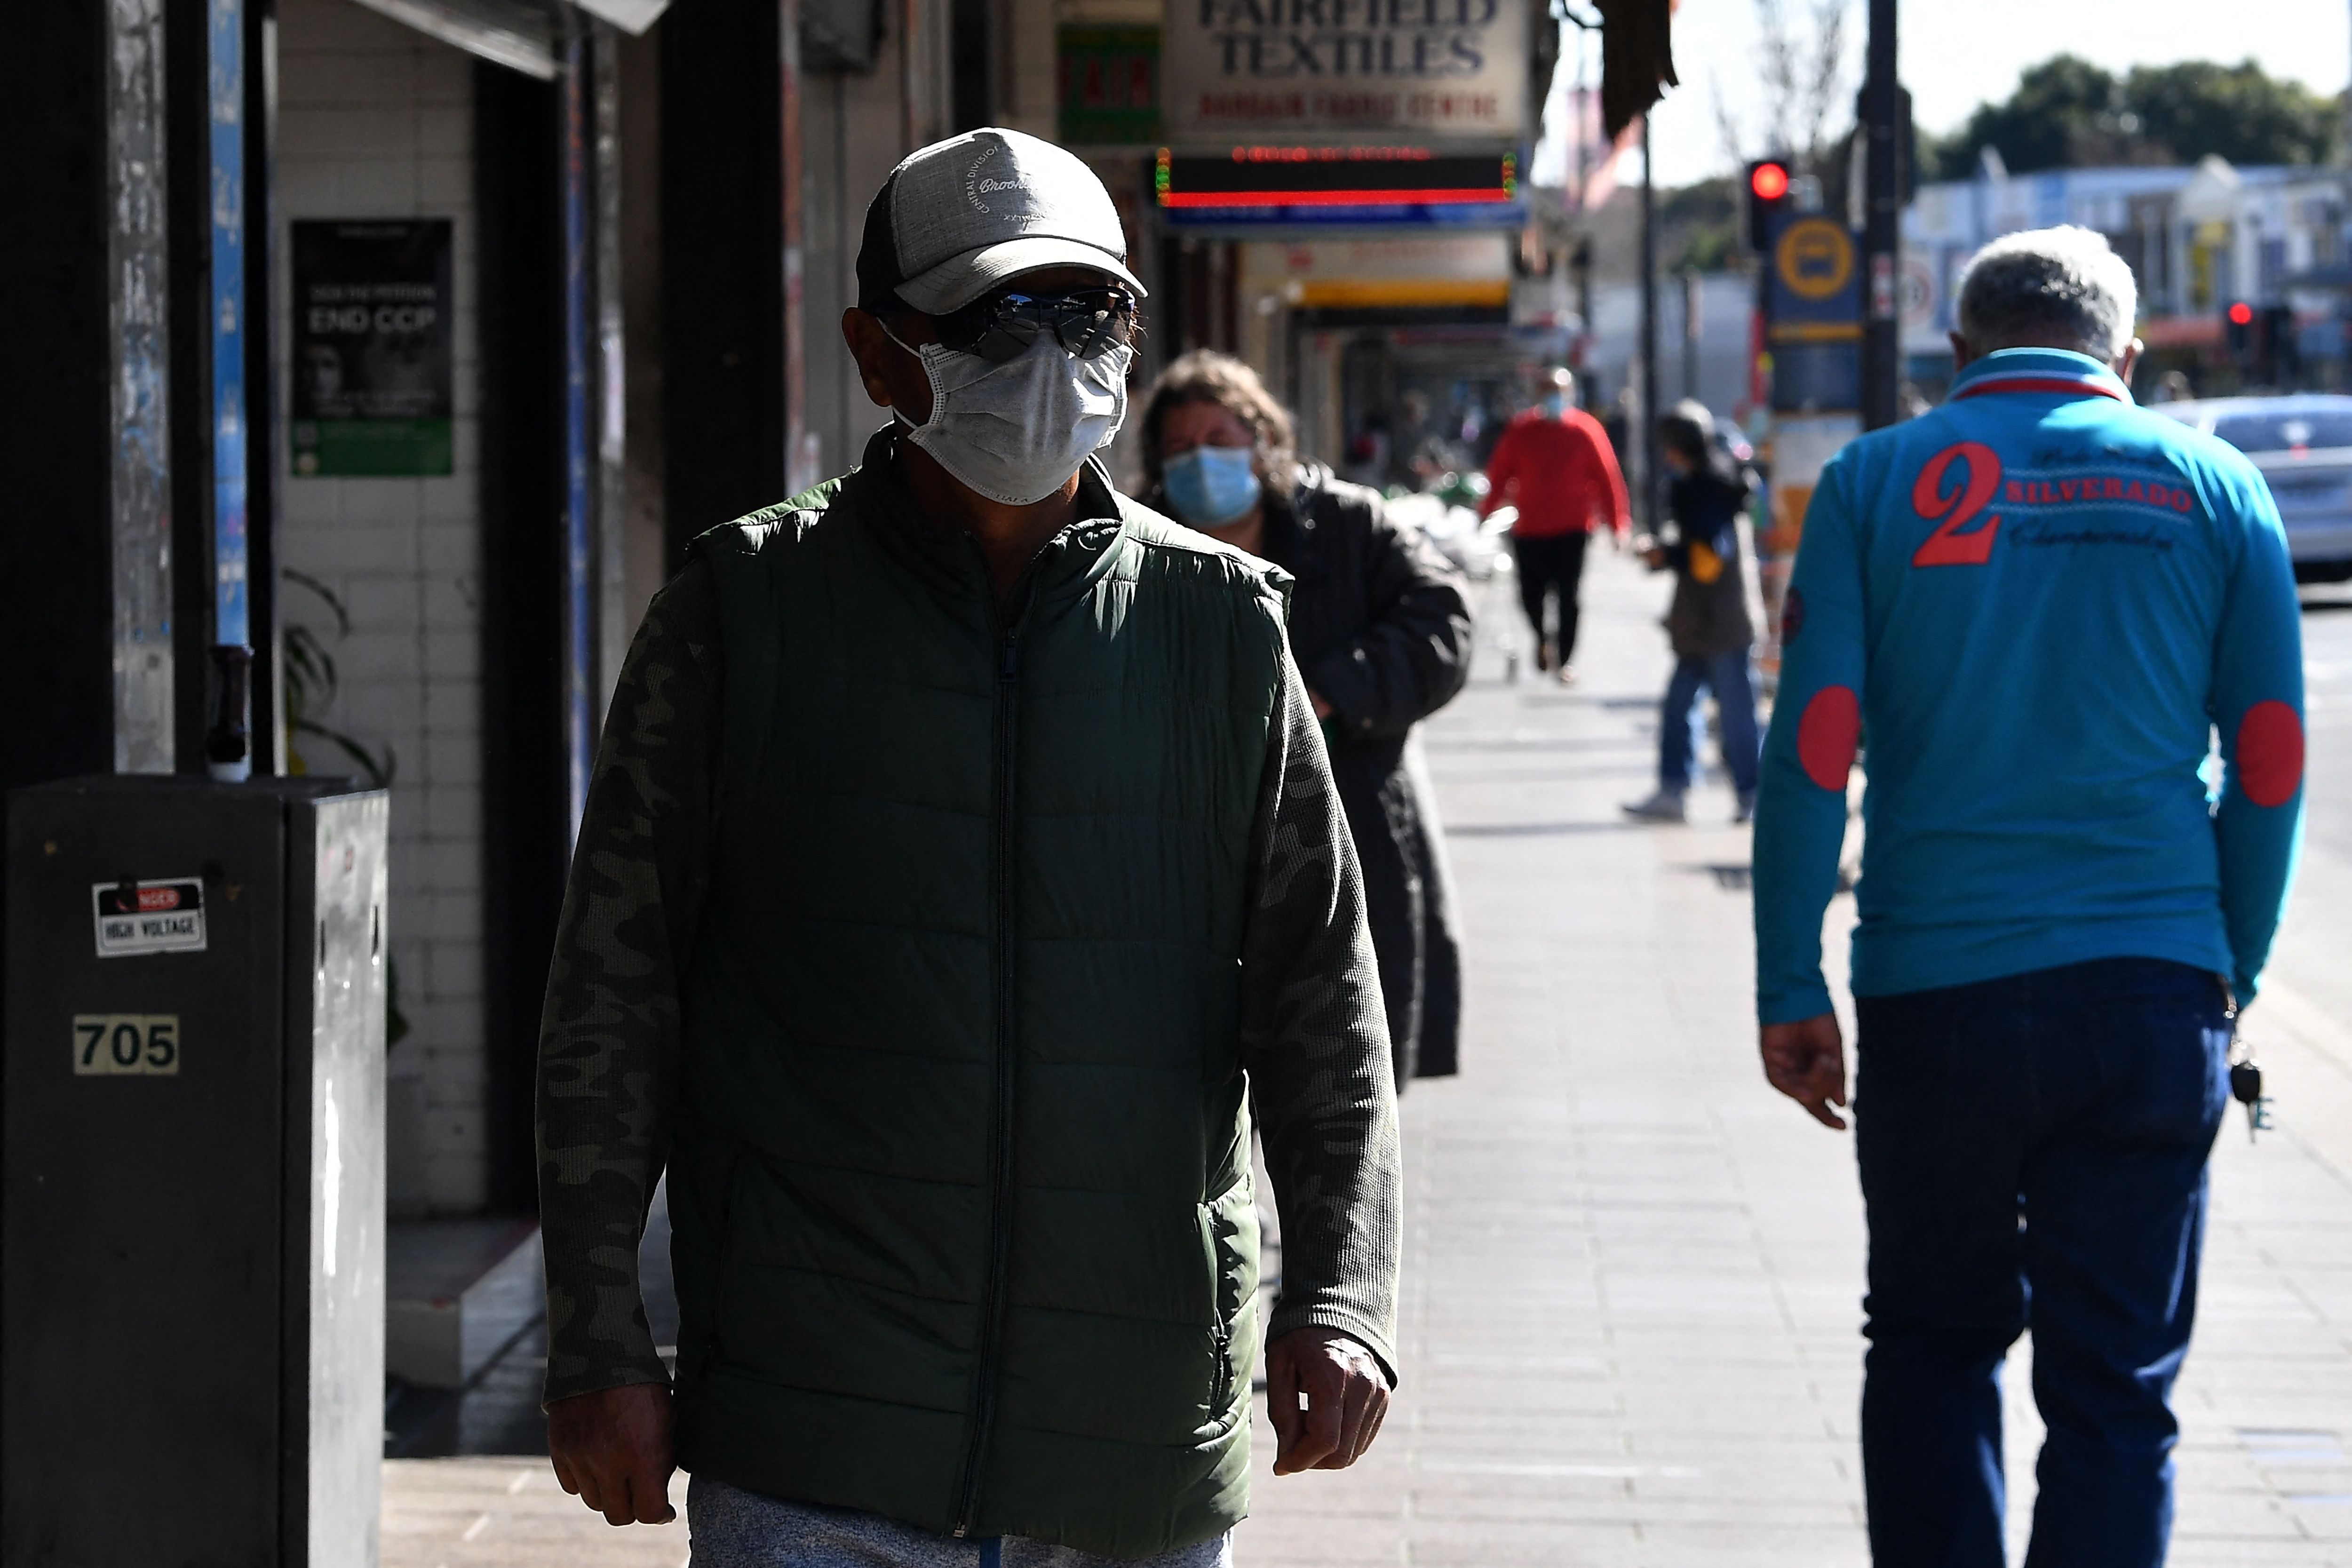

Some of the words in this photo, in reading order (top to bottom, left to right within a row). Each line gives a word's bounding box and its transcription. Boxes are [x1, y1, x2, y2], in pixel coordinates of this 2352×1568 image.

[1199, 0, 1498, 27] FAIRFIELD
[1213, 33, 1484, 77] TEXTILES
[966, 180, 990, 213] CENTRAL
[979, 178, 1027, 193] Brook
[309, 305, 369, 334] END
[374, 305, 437, 334] CCP
[1911, 441, 2002, 567] 2
[2005, 477, 2193, 513] SILVERADO
[107, 922, 135, 939] HIGH
[143, 918, 194, 937] VOLTAGE
[77, 1023, 175, 1067] 705
